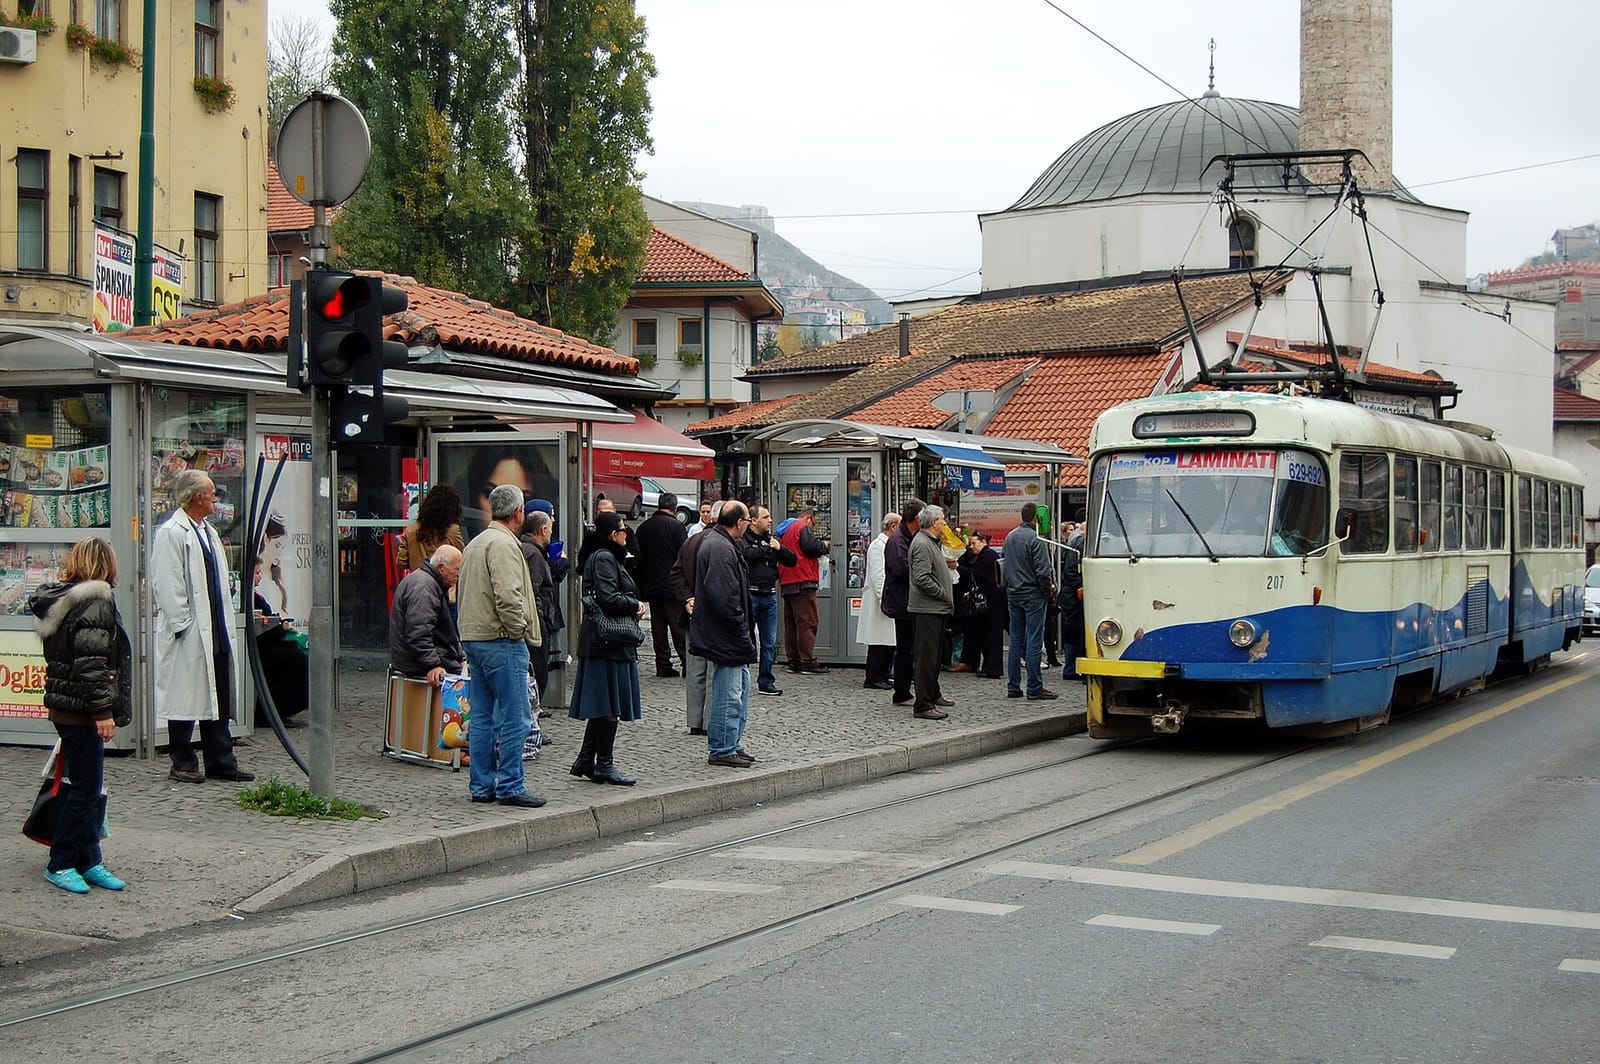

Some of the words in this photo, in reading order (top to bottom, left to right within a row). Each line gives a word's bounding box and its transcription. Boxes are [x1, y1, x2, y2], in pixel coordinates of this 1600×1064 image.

[112, 243, 132, 259] mreža
[95, 260, 132, 301] ŠPANSKA
[111, 292, 132, 326] LIGA
[1177, 451, 1277, 470] LAMINATI
[1288, 462, 1322, 484] 629-692
[1266, 575, 1285, 591] 207
[0, 663, 48, 694] Ogla
